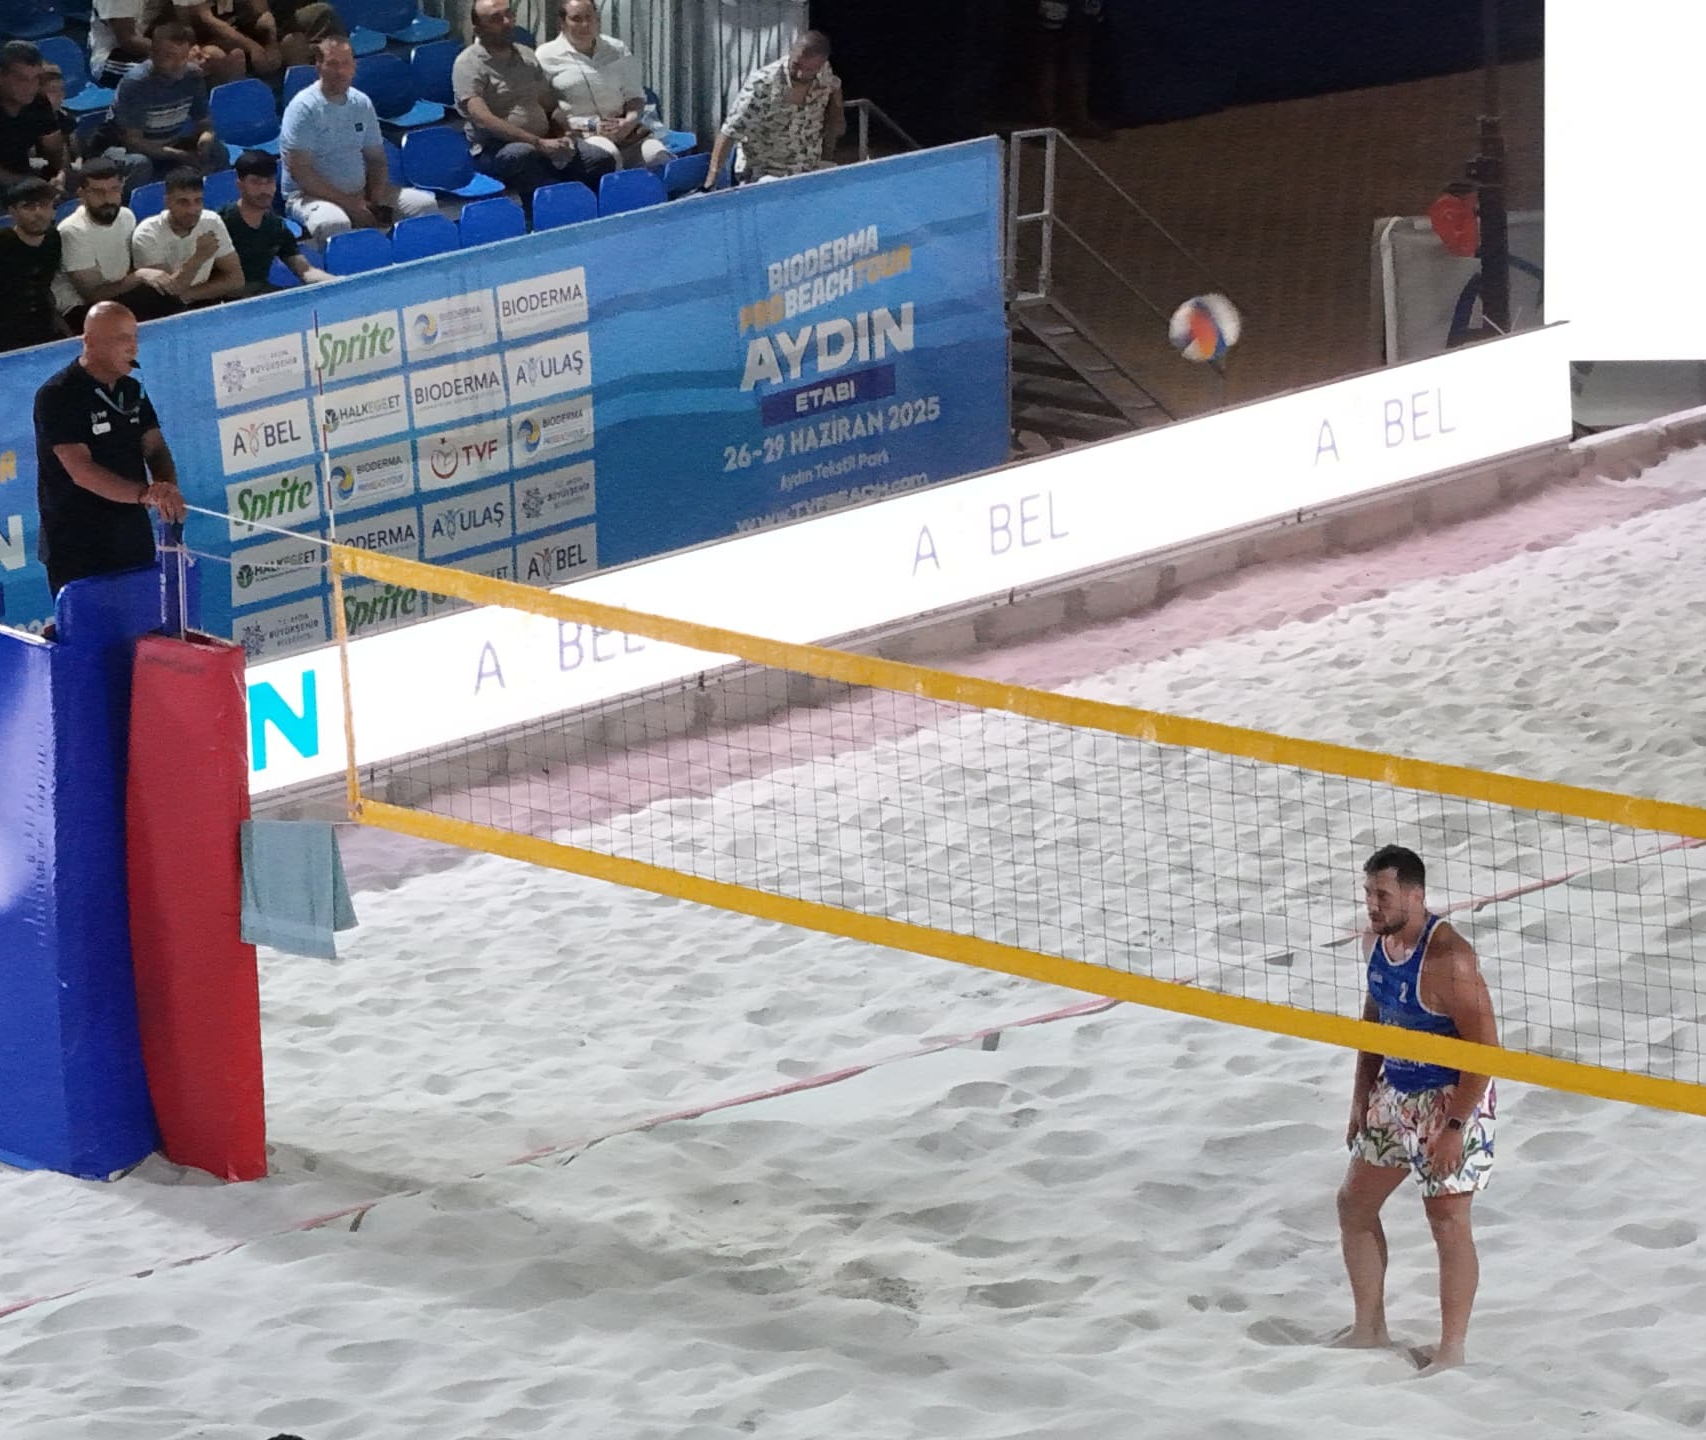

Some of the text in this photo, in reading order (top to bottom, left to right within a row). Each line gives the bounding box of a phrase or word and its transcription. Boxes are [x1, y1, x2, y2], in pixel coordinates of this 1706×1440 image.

[768, 224, 878, 291] BIODERMA
[502, 284, 583, 317] BIODERMA
[315, 322, 395, 376] Sprite
[740, 302, 914, 392] AYDIN
[414, 371, 500, 404] BIODERMA
[796, 381, 855, 412] ETABI
[462, 440, 498, 466] TVF
[724, 396, 940, 472] 26-29 HAZİRAN 2025
[357, 456, 403, 474] BIODERMA
[234, 476, 313, 531] Sprite
[344, 584, 418, 635] Sprite
